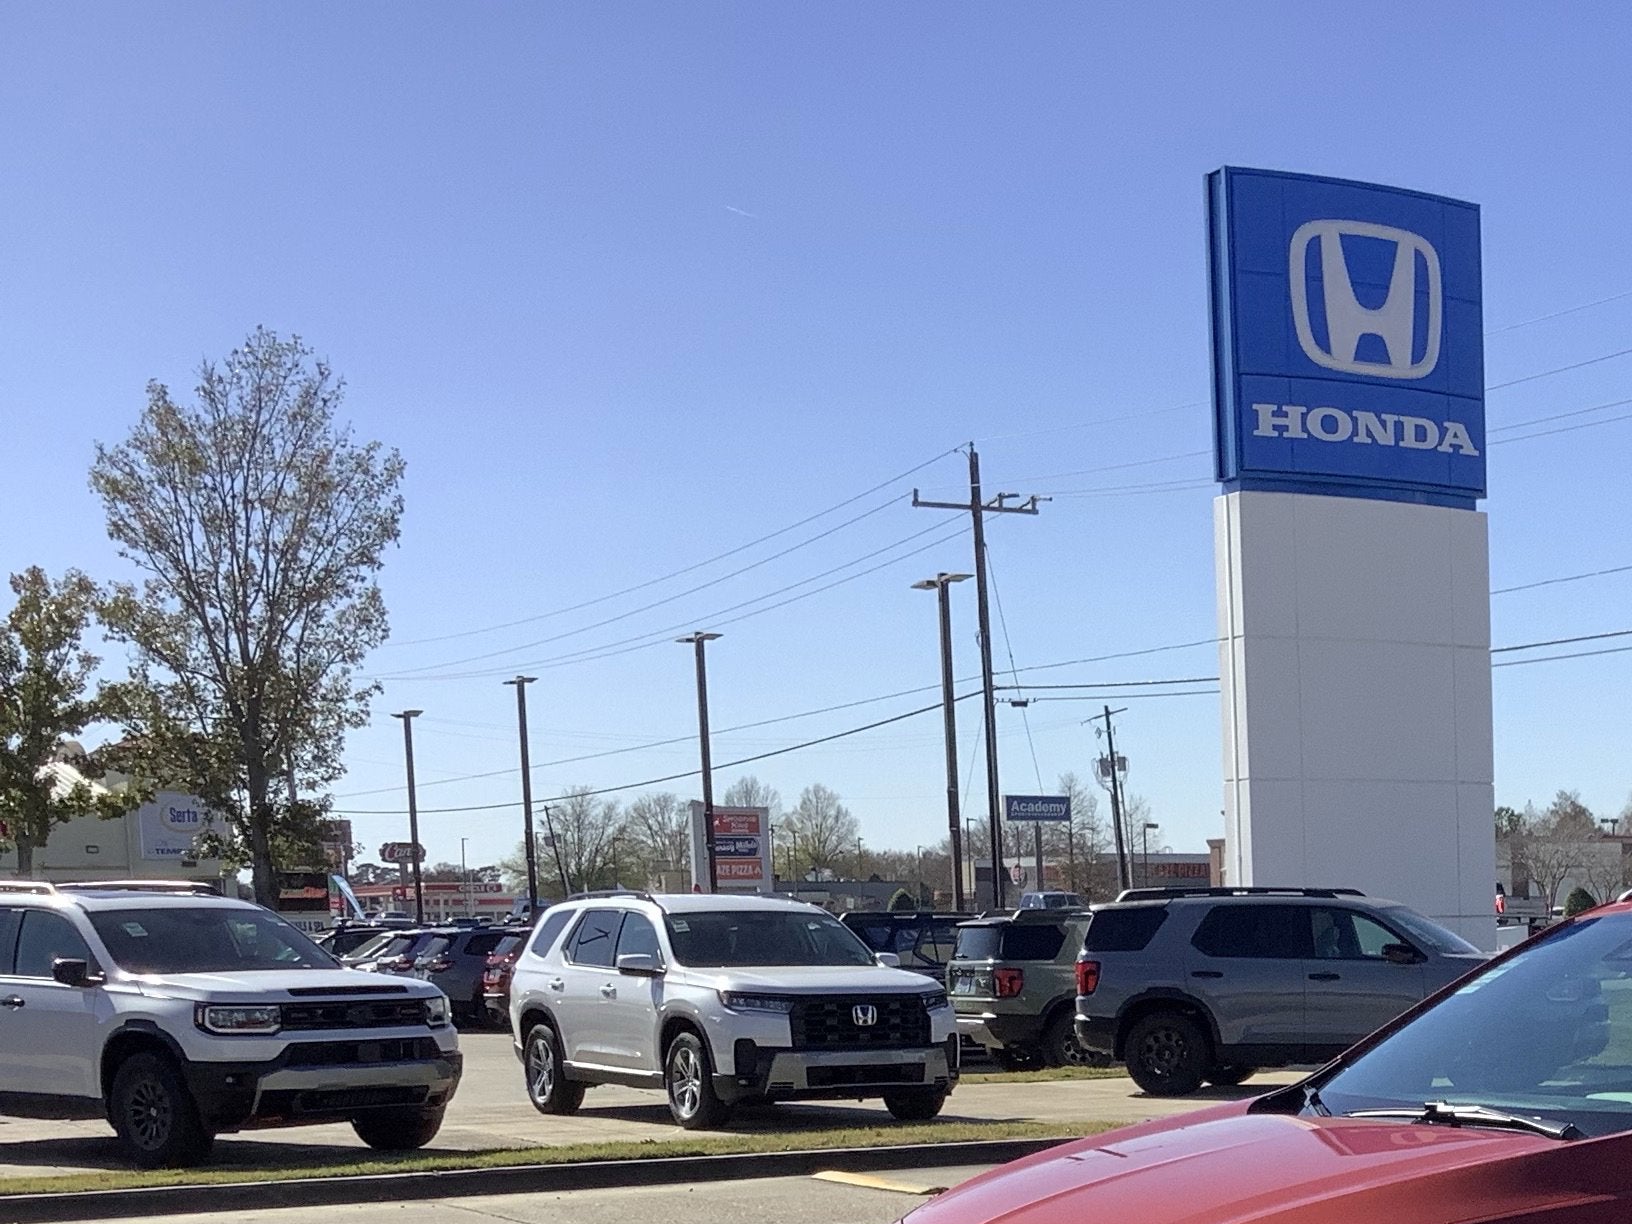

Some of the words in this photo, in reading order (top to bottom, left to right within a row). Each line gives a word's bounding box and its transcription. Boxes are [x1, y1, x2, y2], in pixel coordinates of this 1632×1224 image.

[1252, 403, 1479, 456] HONDA
[169, 807, 198, 823] Serta
[1010, 800, 1067, 816] Academy
[731, 865, 754, 876] PIZZA
